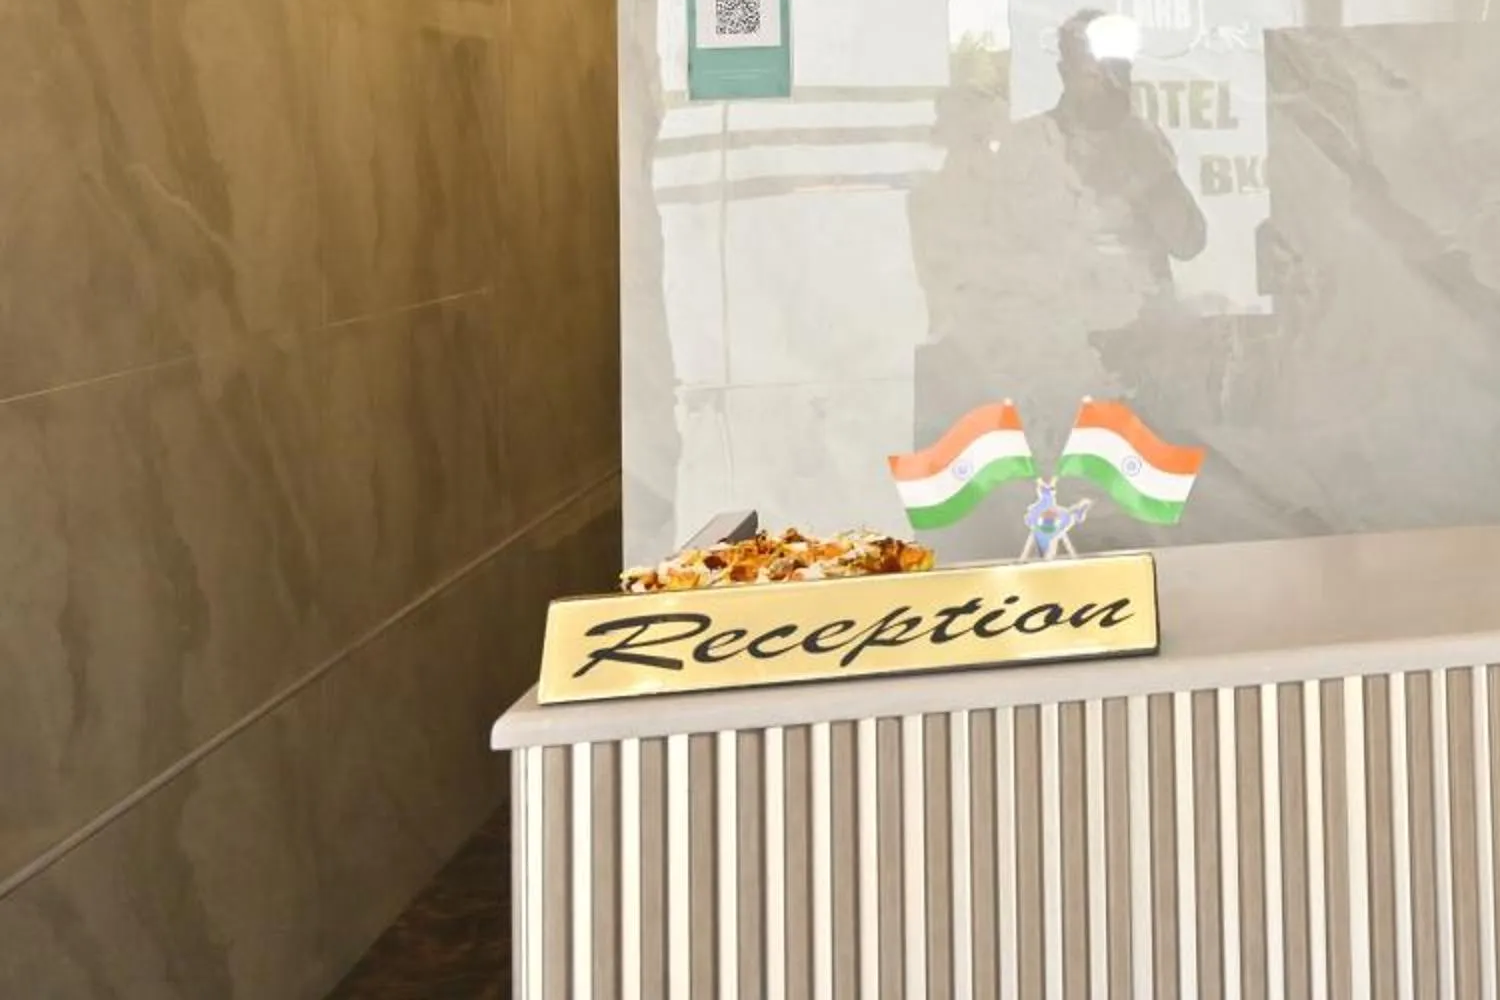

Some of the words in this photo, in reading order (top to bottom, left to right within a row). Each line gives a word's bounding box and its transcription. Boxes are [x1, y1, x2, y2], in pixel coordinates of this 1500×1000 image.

[1130, 79, 1238, 130] OTEL
[1200, 154, 1268, 196] BK
[572, 595, 1136, 678] Reception
